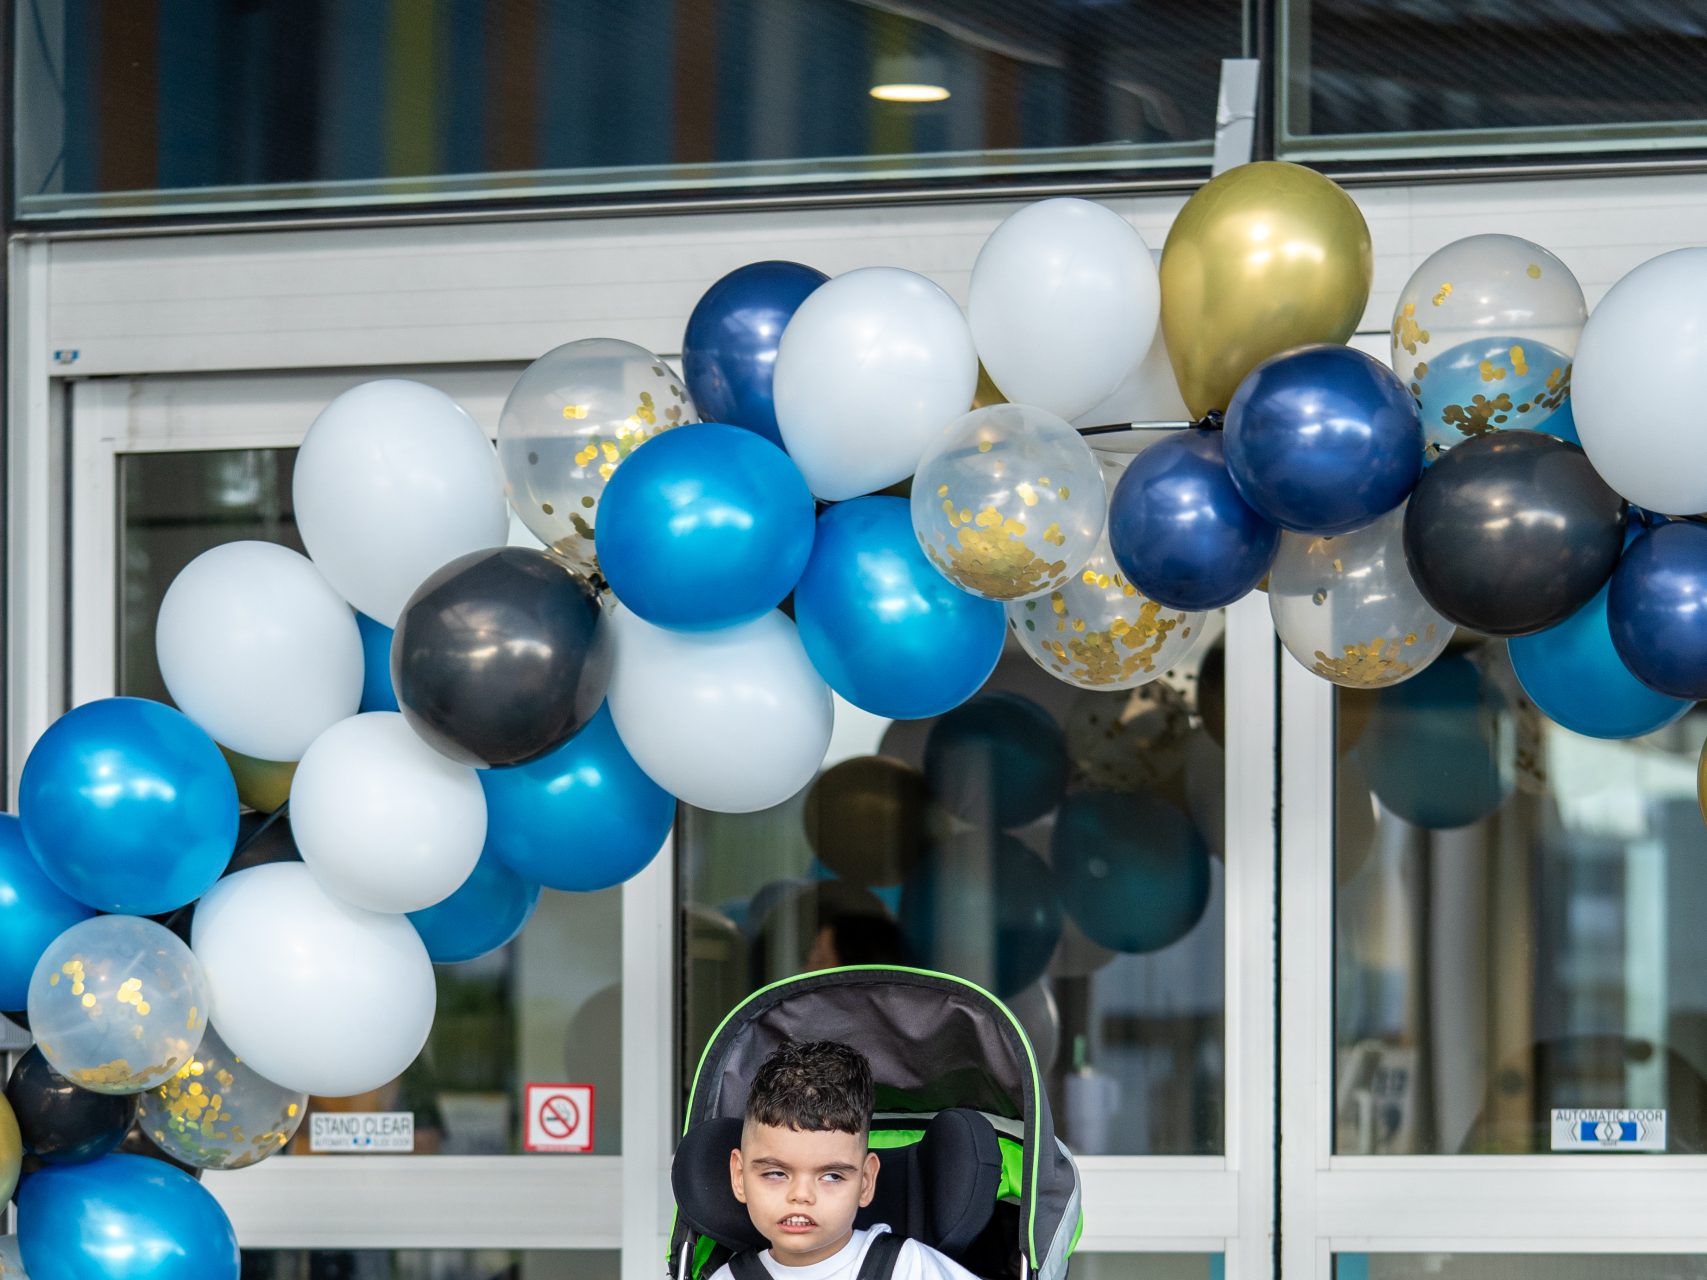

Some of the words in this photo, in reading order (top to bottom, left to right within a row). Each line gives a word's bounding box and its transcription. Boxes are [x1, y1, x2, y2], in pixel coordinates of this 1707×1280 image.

[1556, 1110, 1624, 1121] AUTOMATIC
[1628, 1110, 1662, 1121] DOOR
[314, 1116, 360, 1136] STAND
[363, 1116, 412, 1136] CLEAR
